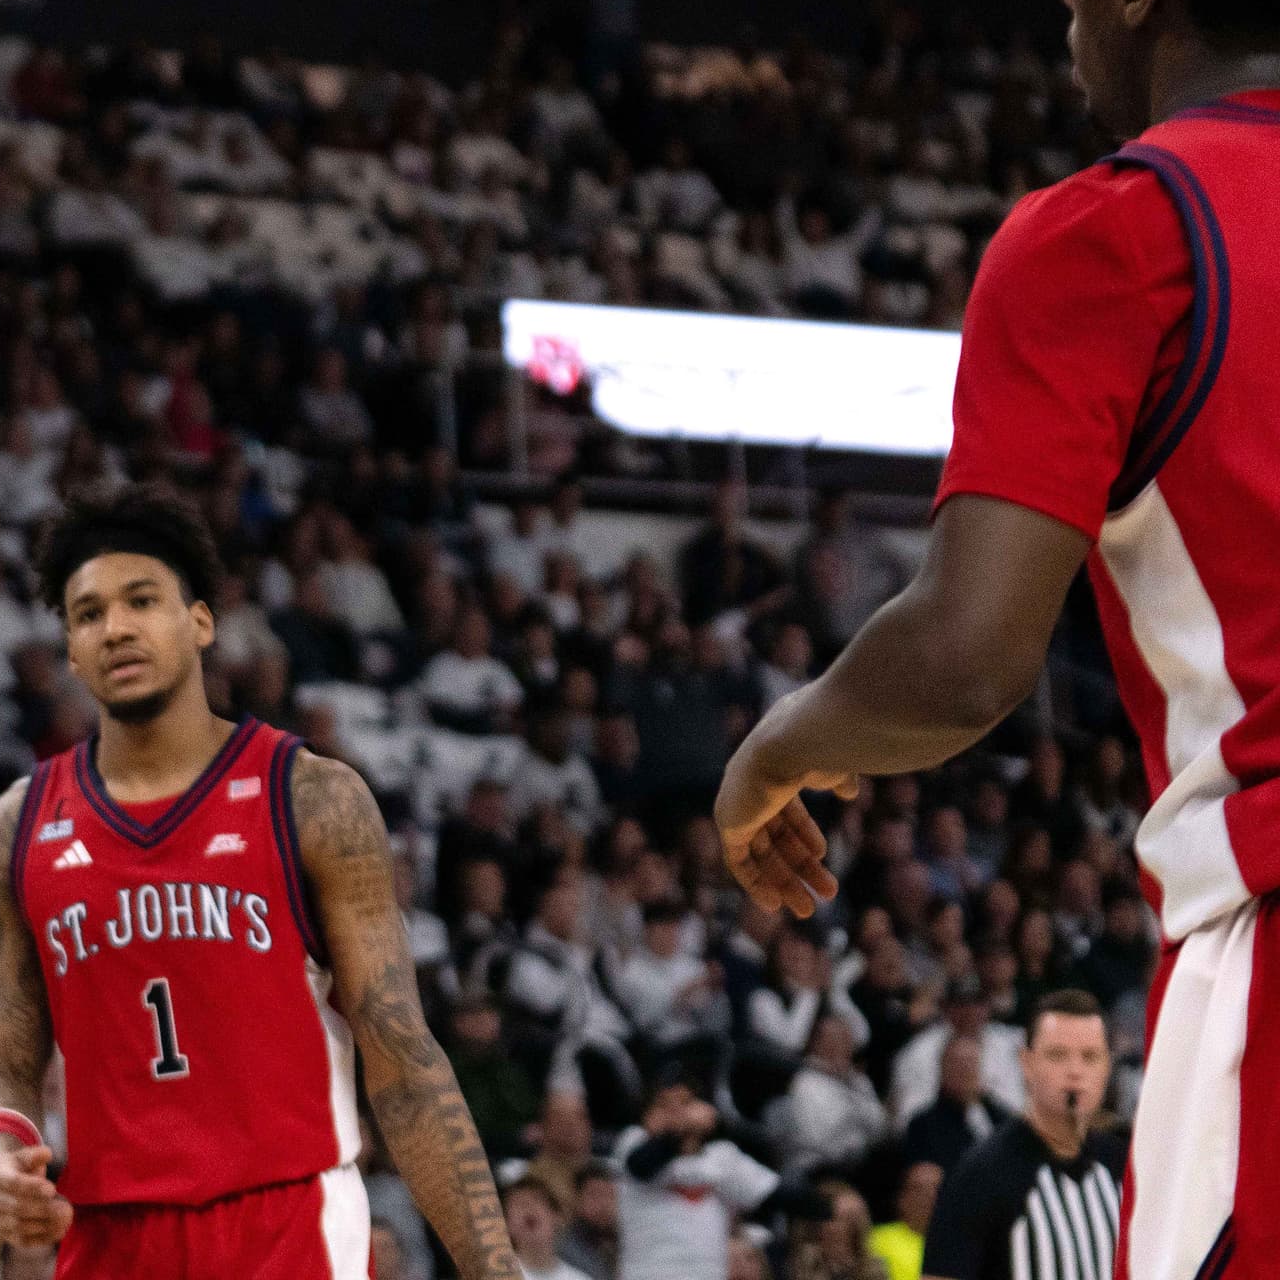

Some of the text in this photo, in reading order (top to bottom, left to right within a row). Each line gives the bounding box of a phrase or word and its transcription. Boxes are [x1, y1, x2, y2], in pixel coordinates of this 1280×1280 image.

[46, 882, 273, 977] ST. JOHN'S
[143, 977, 190, 1079] 1
